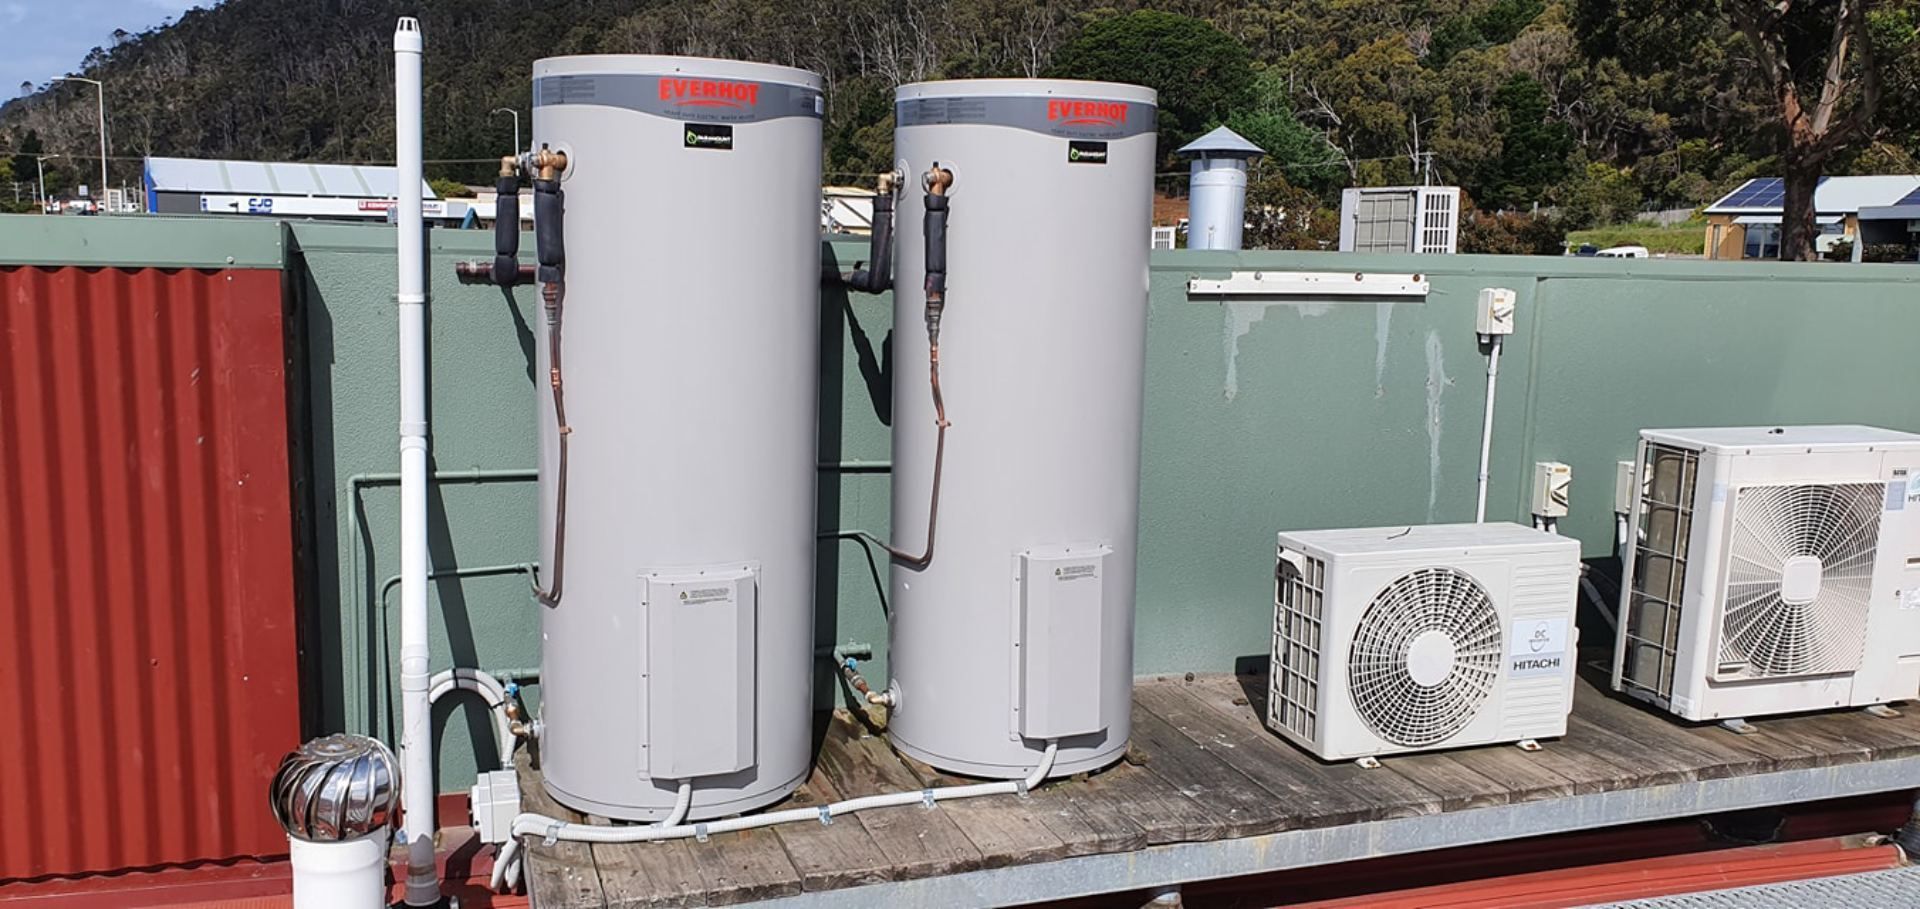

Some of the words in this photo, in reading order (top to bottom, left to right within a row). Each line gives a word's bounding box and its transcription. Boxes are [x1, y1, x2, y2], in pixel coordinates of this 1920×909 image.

[658, 77, 760, 106] EVERHOT
[1048, 98, 1127, 124] EVERHOT
[1513, 657, 1560, 671] HITACHI
